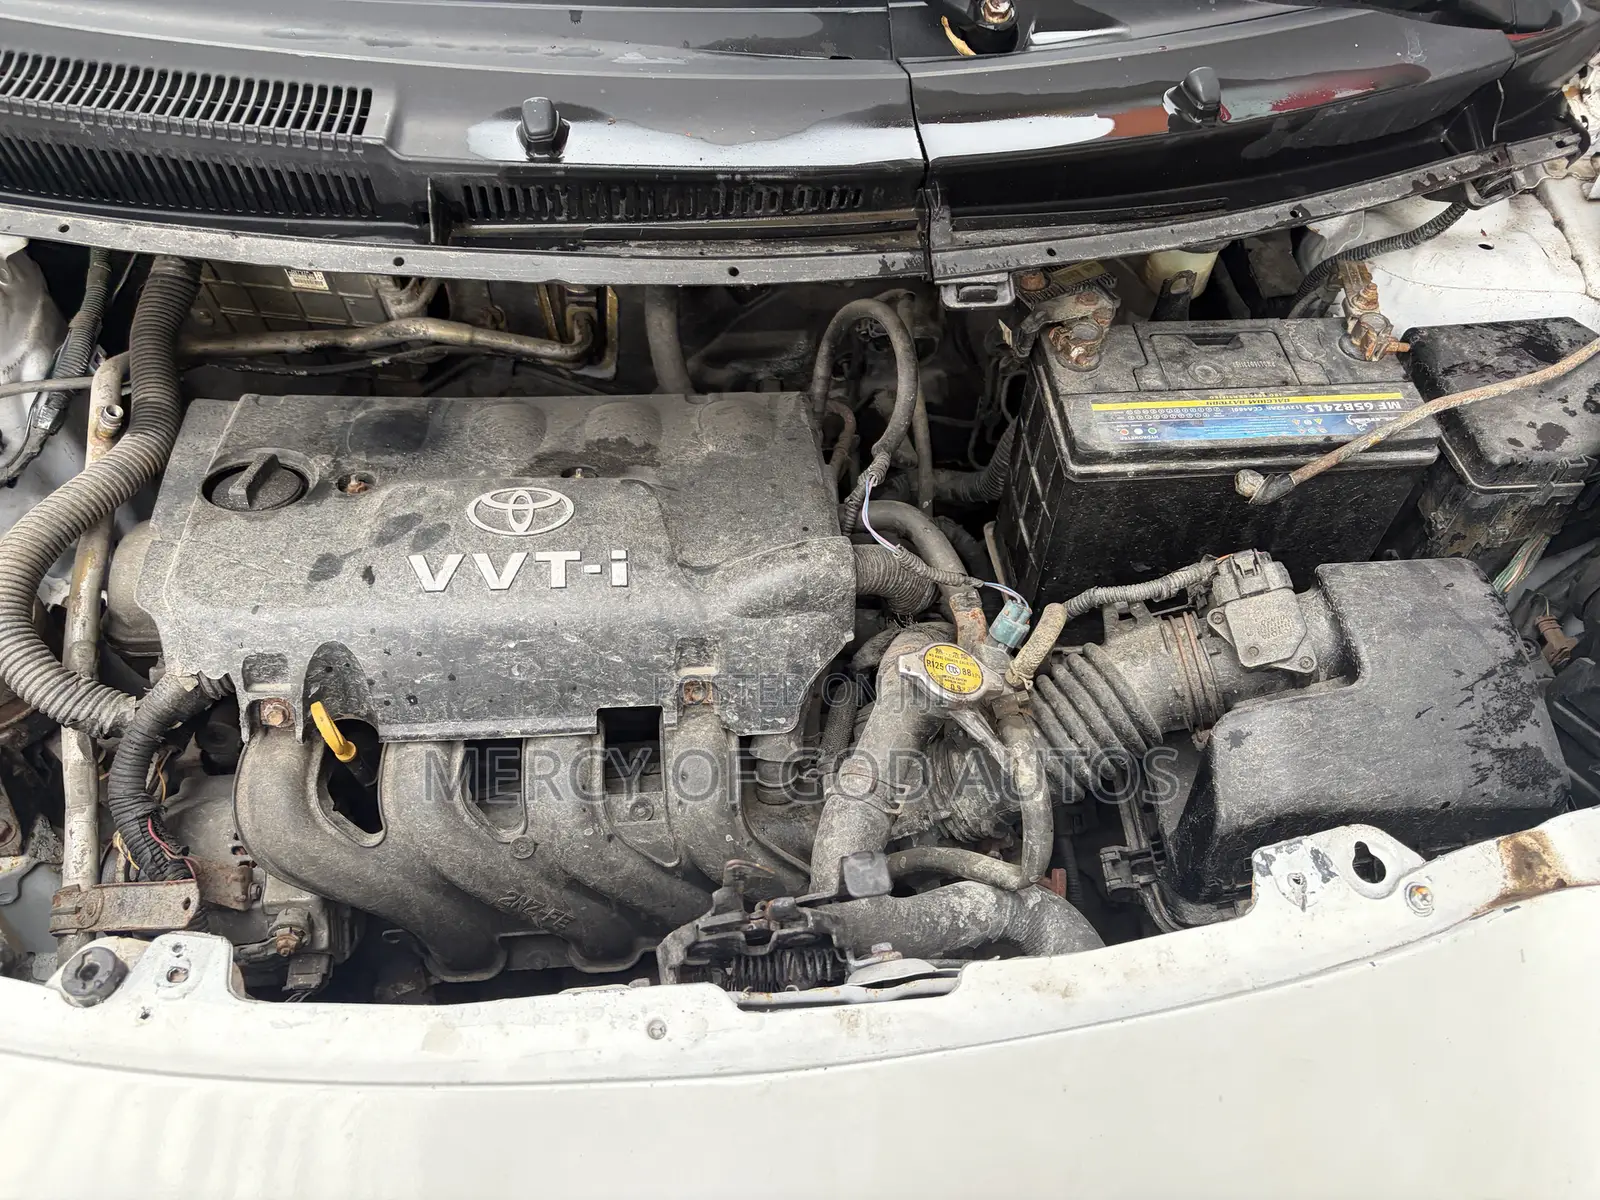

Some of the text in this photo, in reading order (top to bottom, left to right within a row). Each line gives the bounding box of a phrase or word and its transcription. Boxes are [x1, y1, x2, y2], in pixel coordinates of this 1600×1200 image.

[1305, 402, 1374, 413] 65B24LS
[1379, 401, 1402, 410] MF
[405, 549, 629, 593] VVT-i
